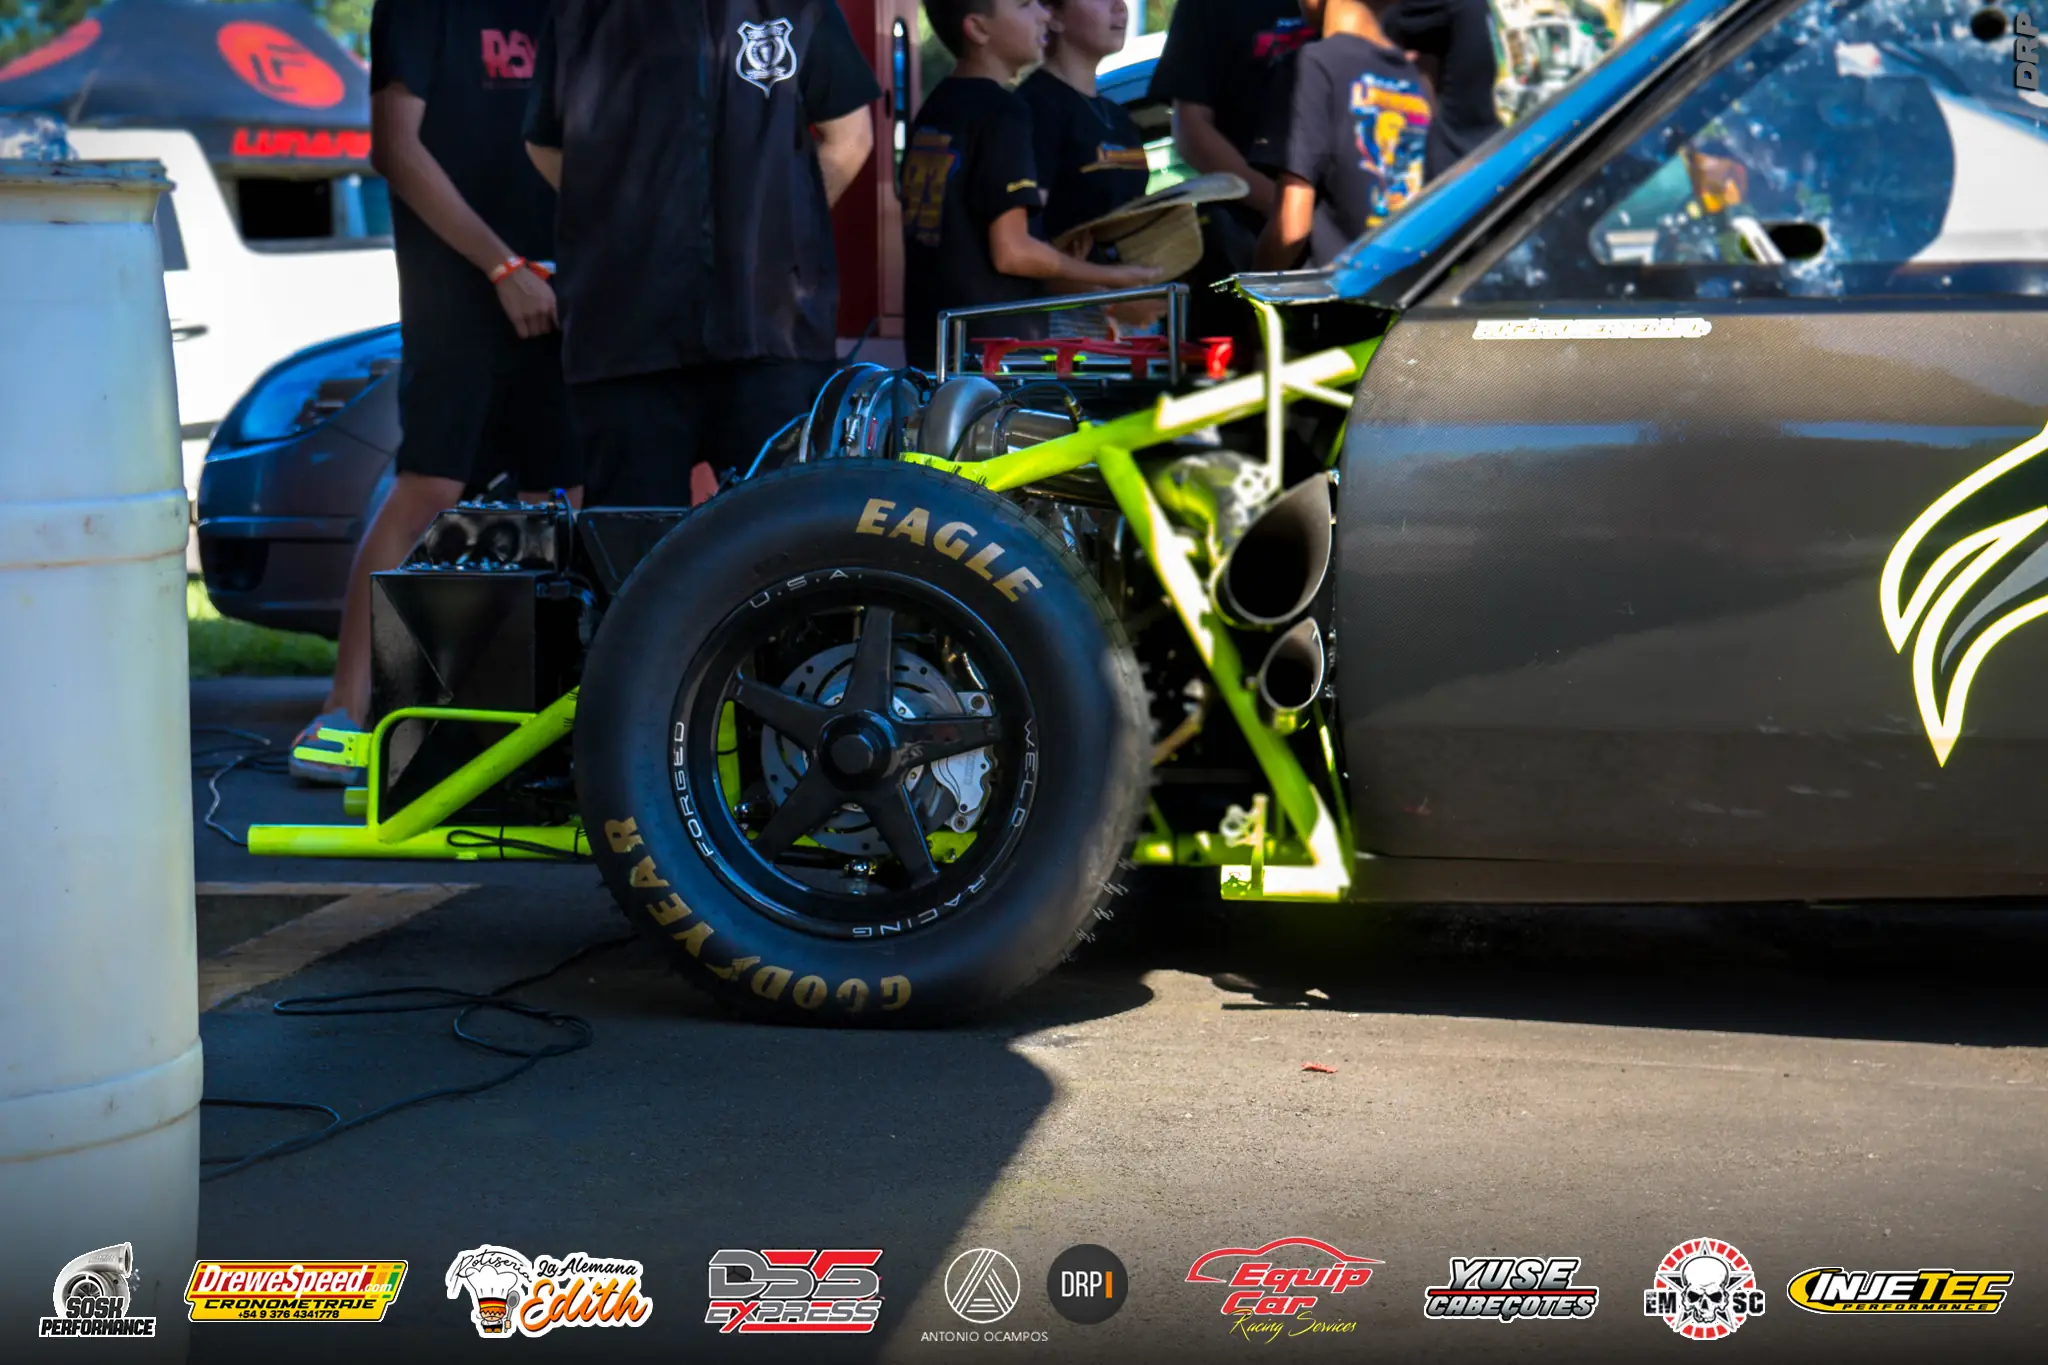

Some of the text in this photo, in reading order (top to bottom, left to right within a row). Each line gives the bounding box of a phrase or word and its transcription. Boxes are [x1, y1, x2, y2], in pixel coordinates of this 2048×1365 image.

[855, 498, 1043, 602] EAGLE
[673, 721, 714, 857] FORGED
[852, 718, 1036, 938] WELD RACING
